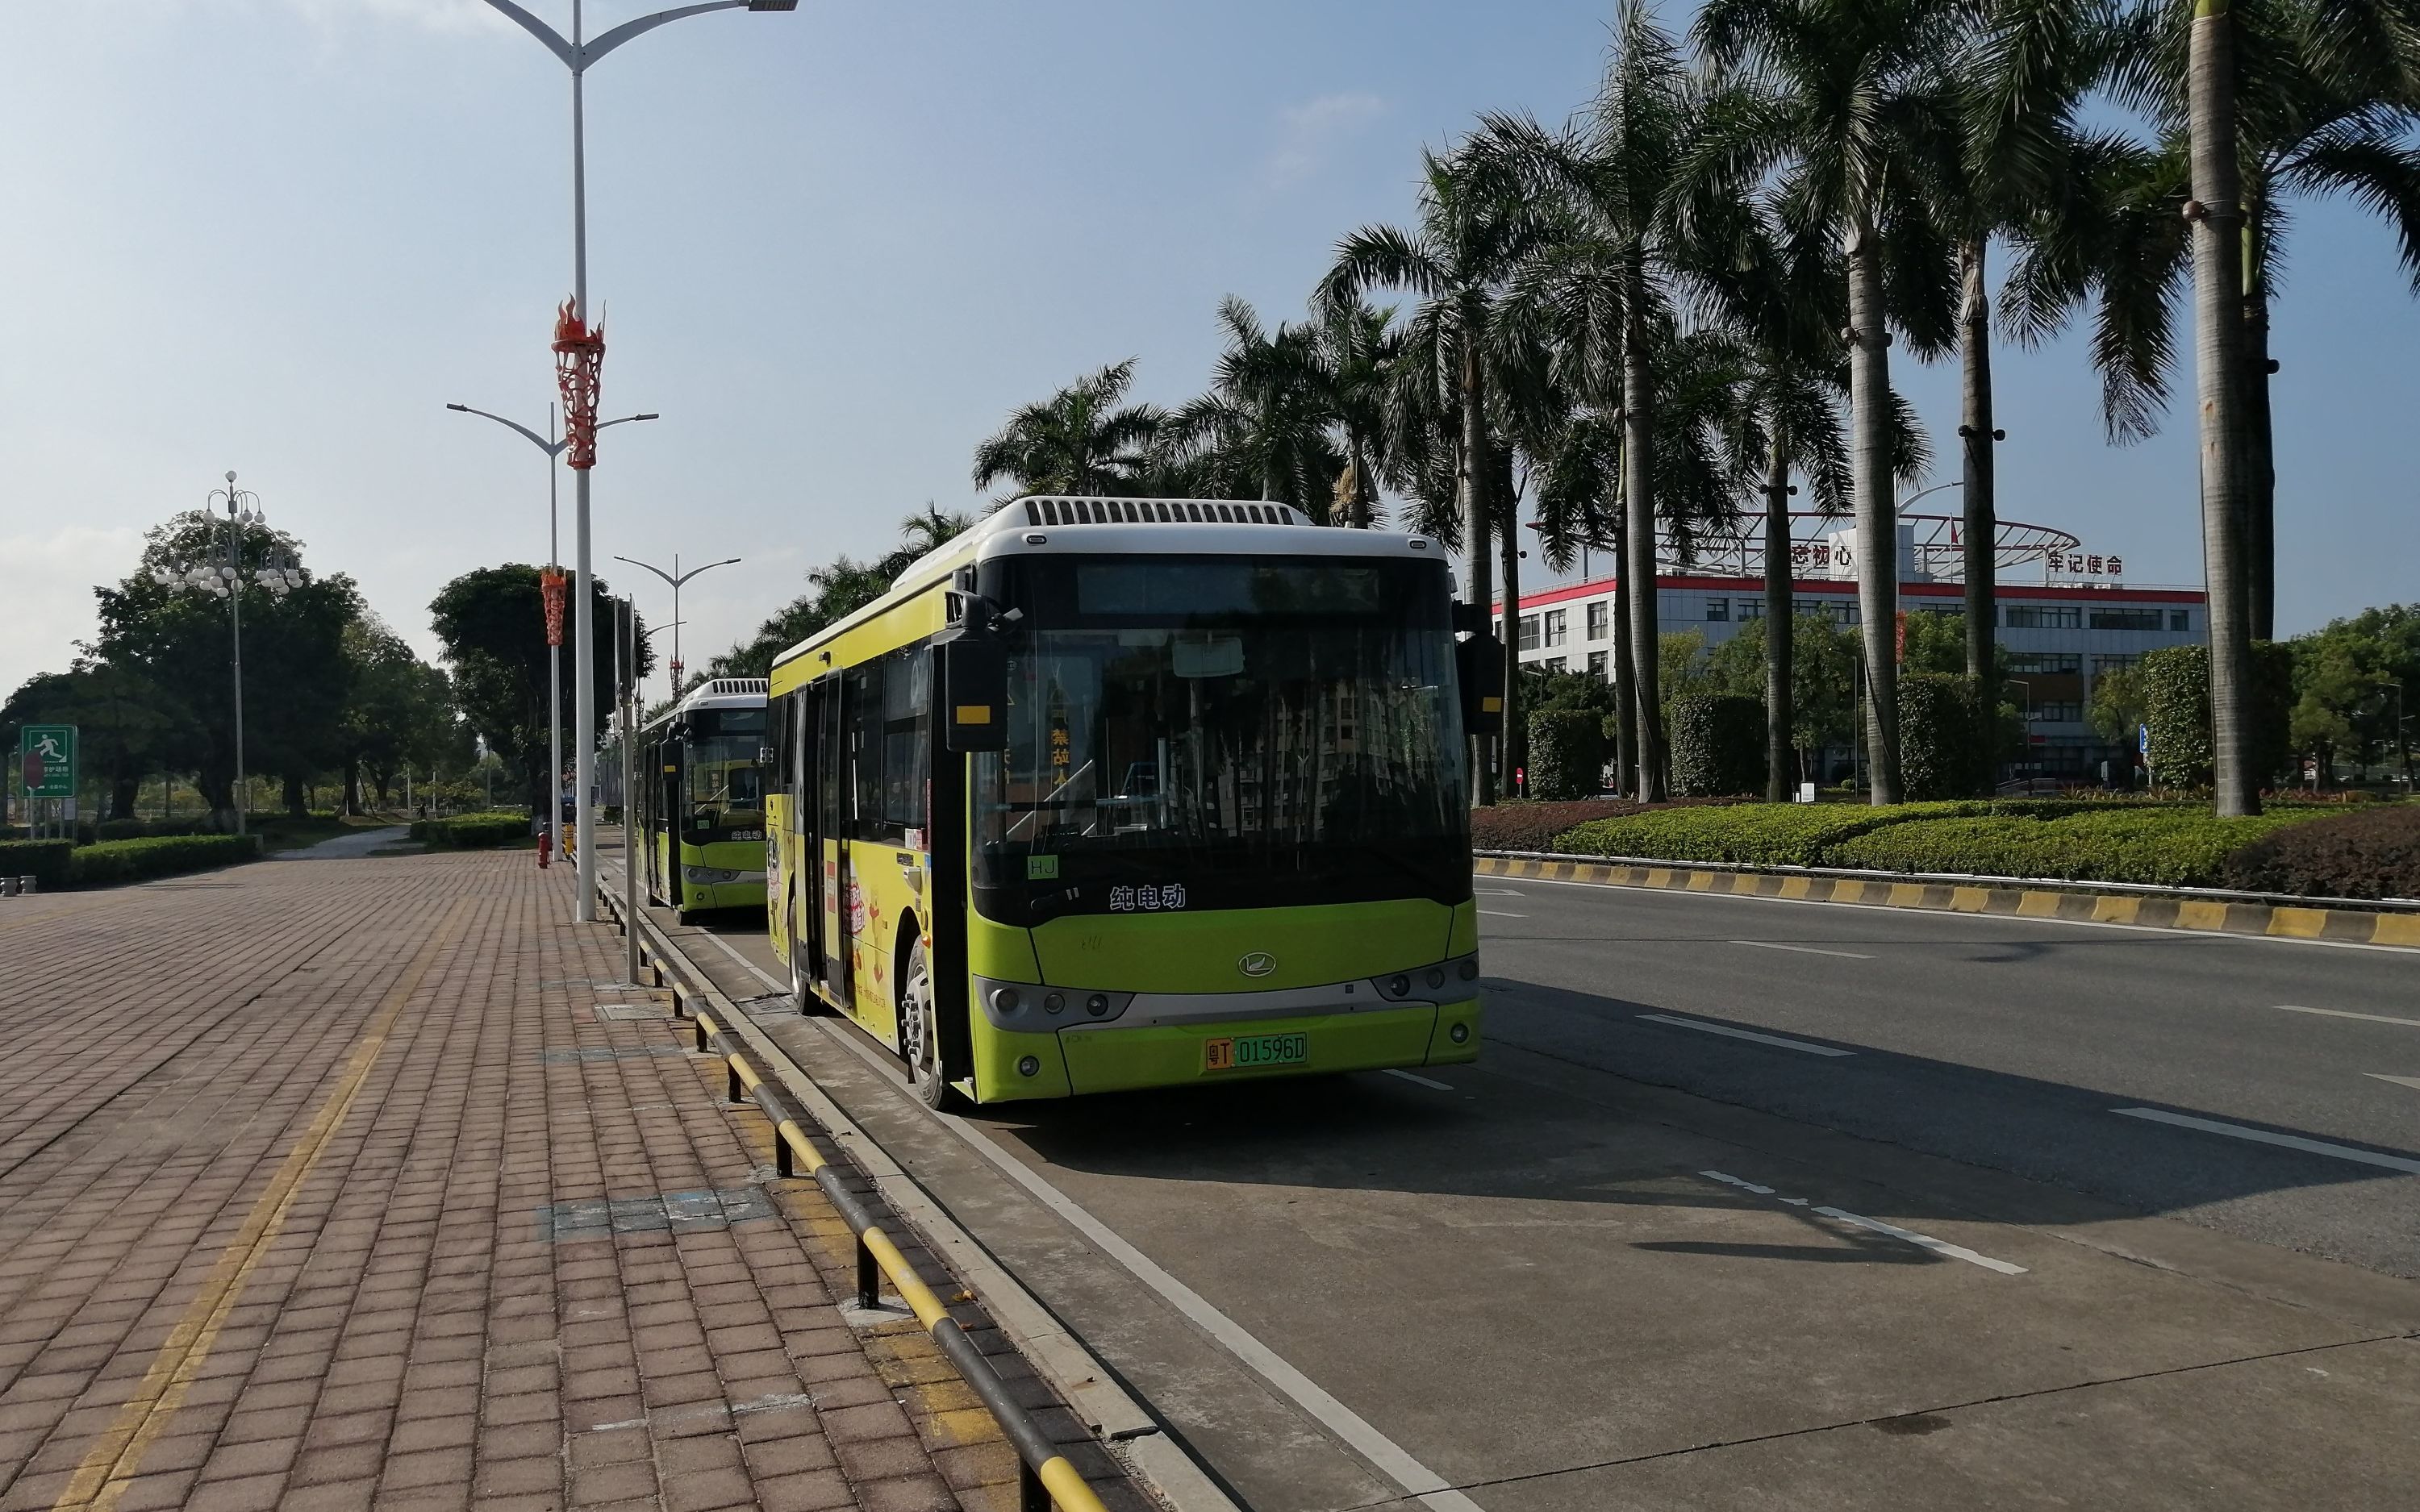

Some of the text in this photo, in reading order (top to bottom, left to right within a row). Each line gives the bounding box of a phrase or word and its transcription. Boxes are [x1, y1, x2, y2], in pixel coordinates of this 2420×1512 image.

[2048, 551, 2122, 575] 牢记使命
[731, 830, 762, 840] 纯电动
[1031, 860, 1055, 874] HJ
[1109, 883, 1186, 910] 纯电动
